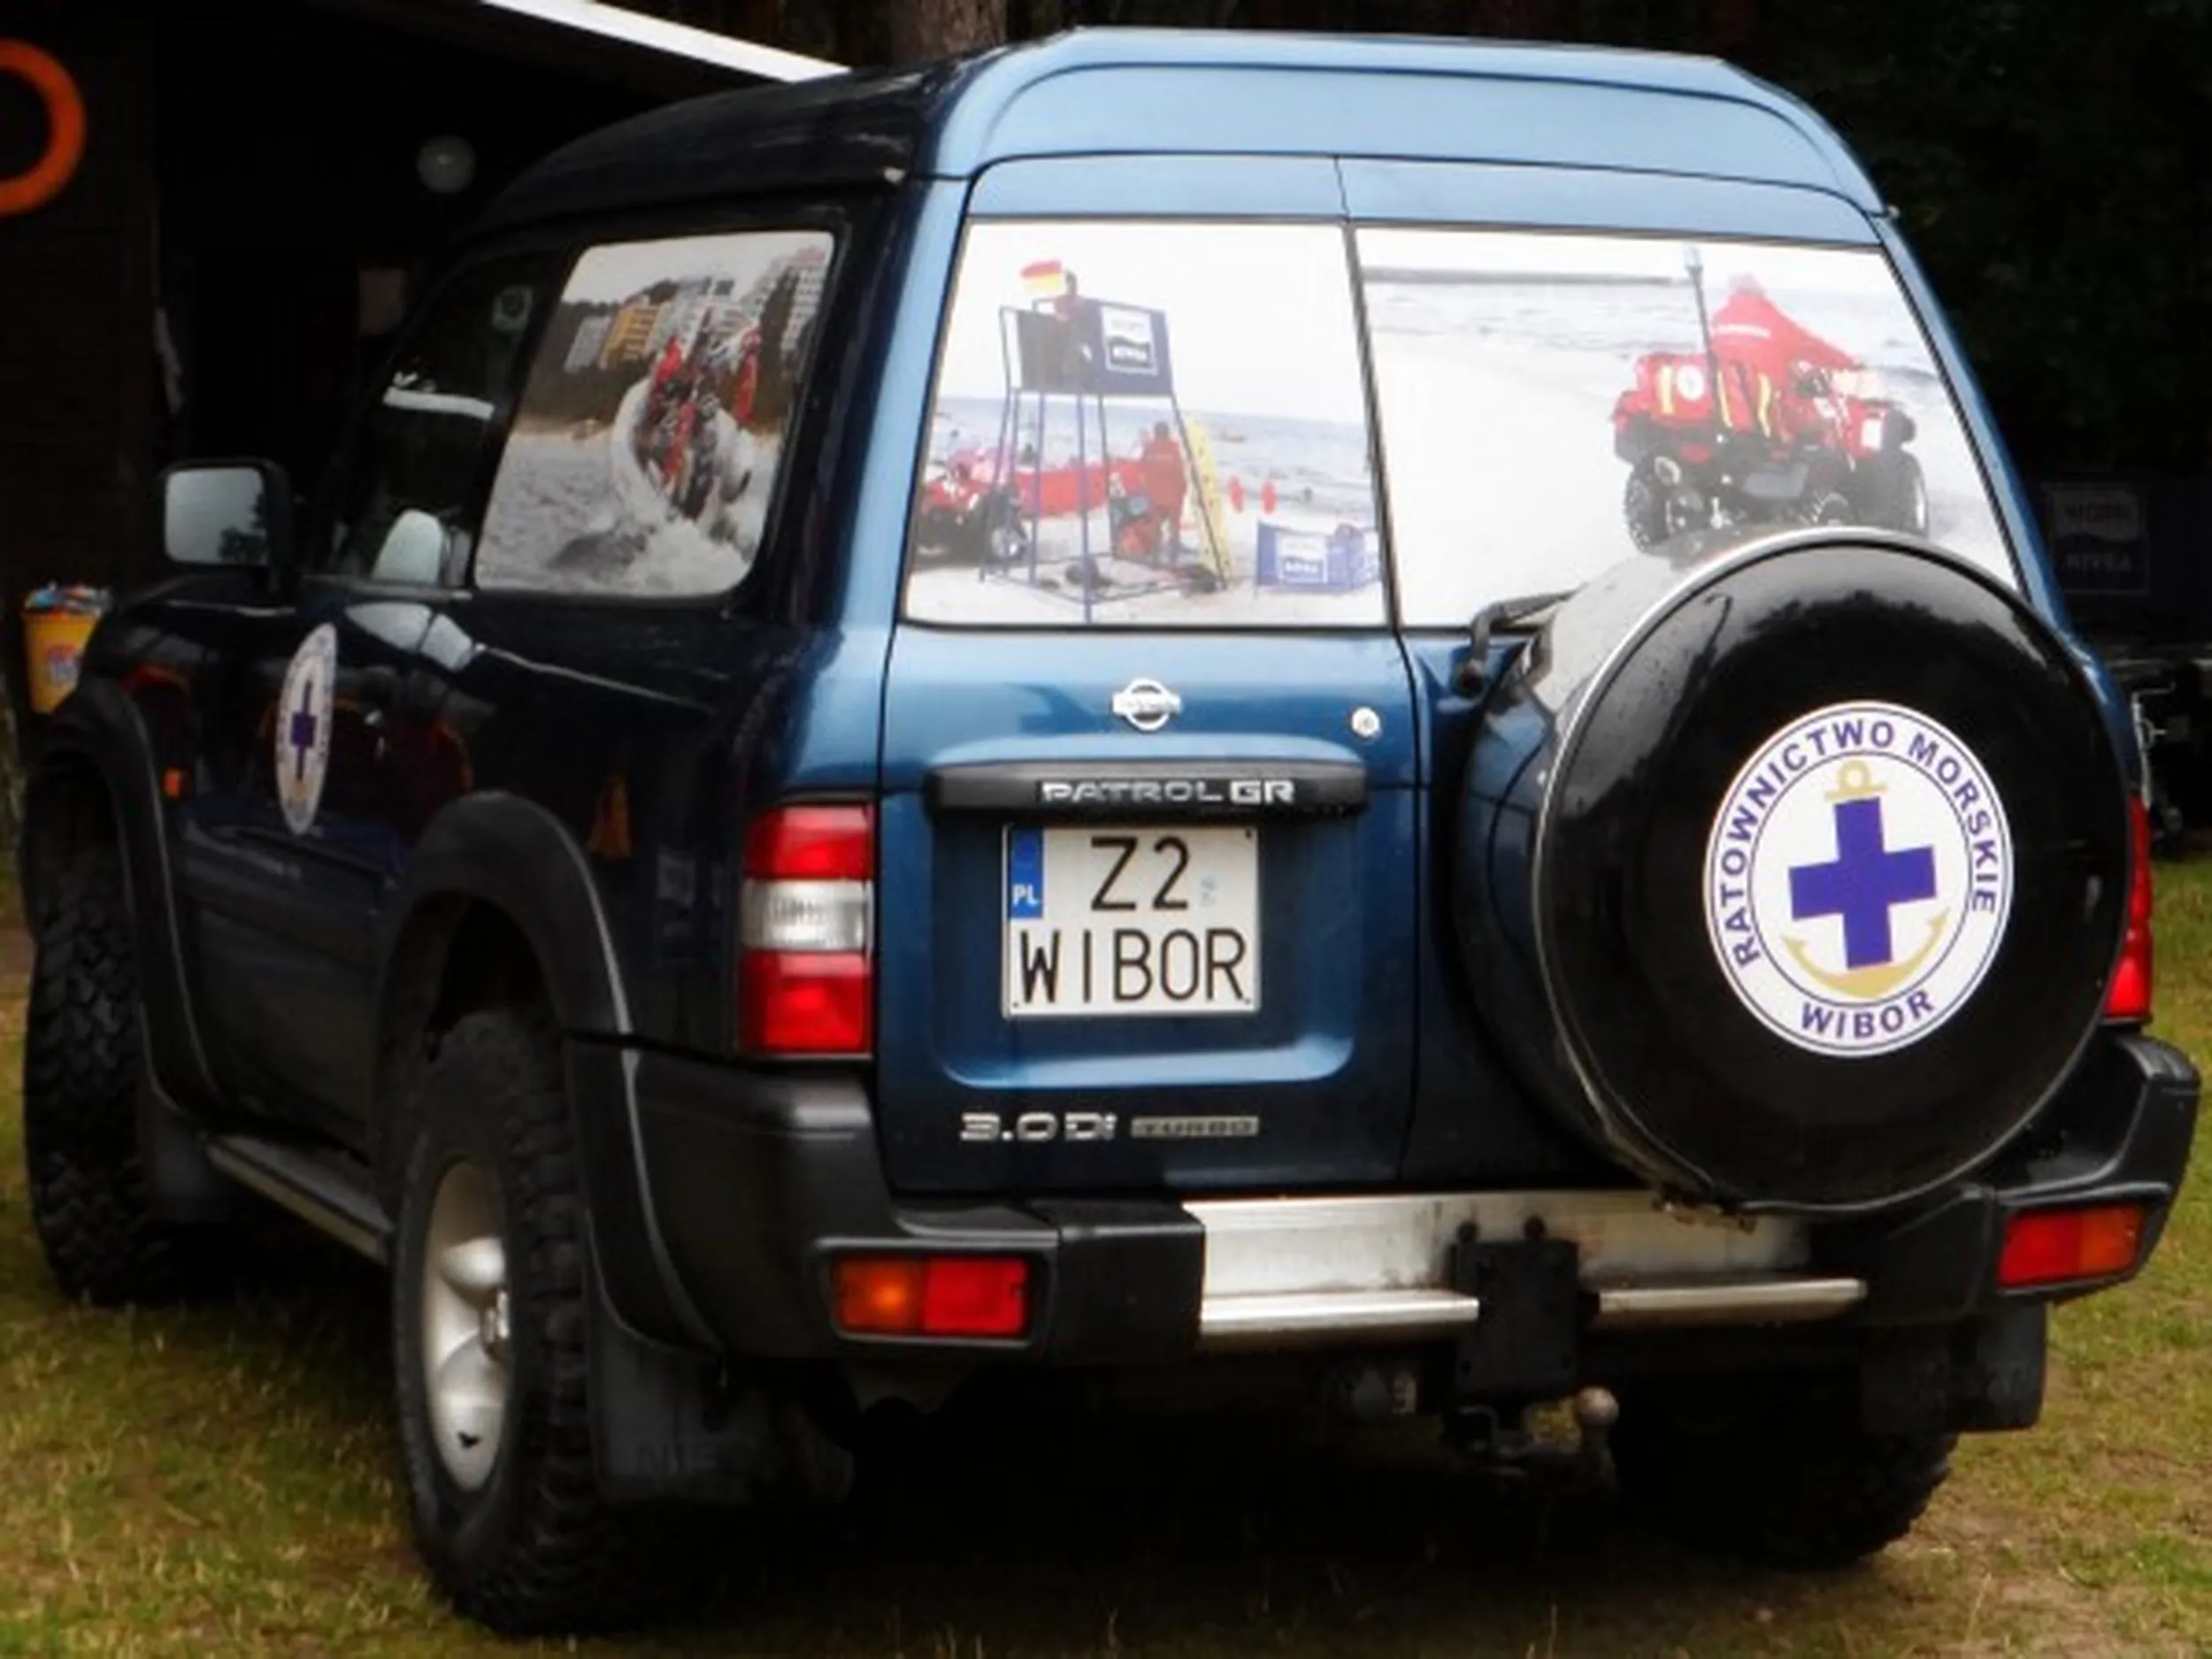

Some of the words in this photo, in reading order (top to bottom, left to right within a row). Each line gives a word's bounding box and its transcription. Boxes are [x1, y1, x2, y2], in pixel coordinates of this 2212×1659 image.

[1042, 780, 1224, 803] PATROL
[1229, 780, 1295, 805] GR
[1090, 835, 1190, 911] Z2
[1720, 719, 1895, 968] RATOWNICTWO
[1908, 733, 1999, 916] MORSKIE
[1012, 886, 1039, 907] PL
[1020, 928, 1248, 1004] WIBOR
[1801, 988, 1936, 1039] WIBOR
